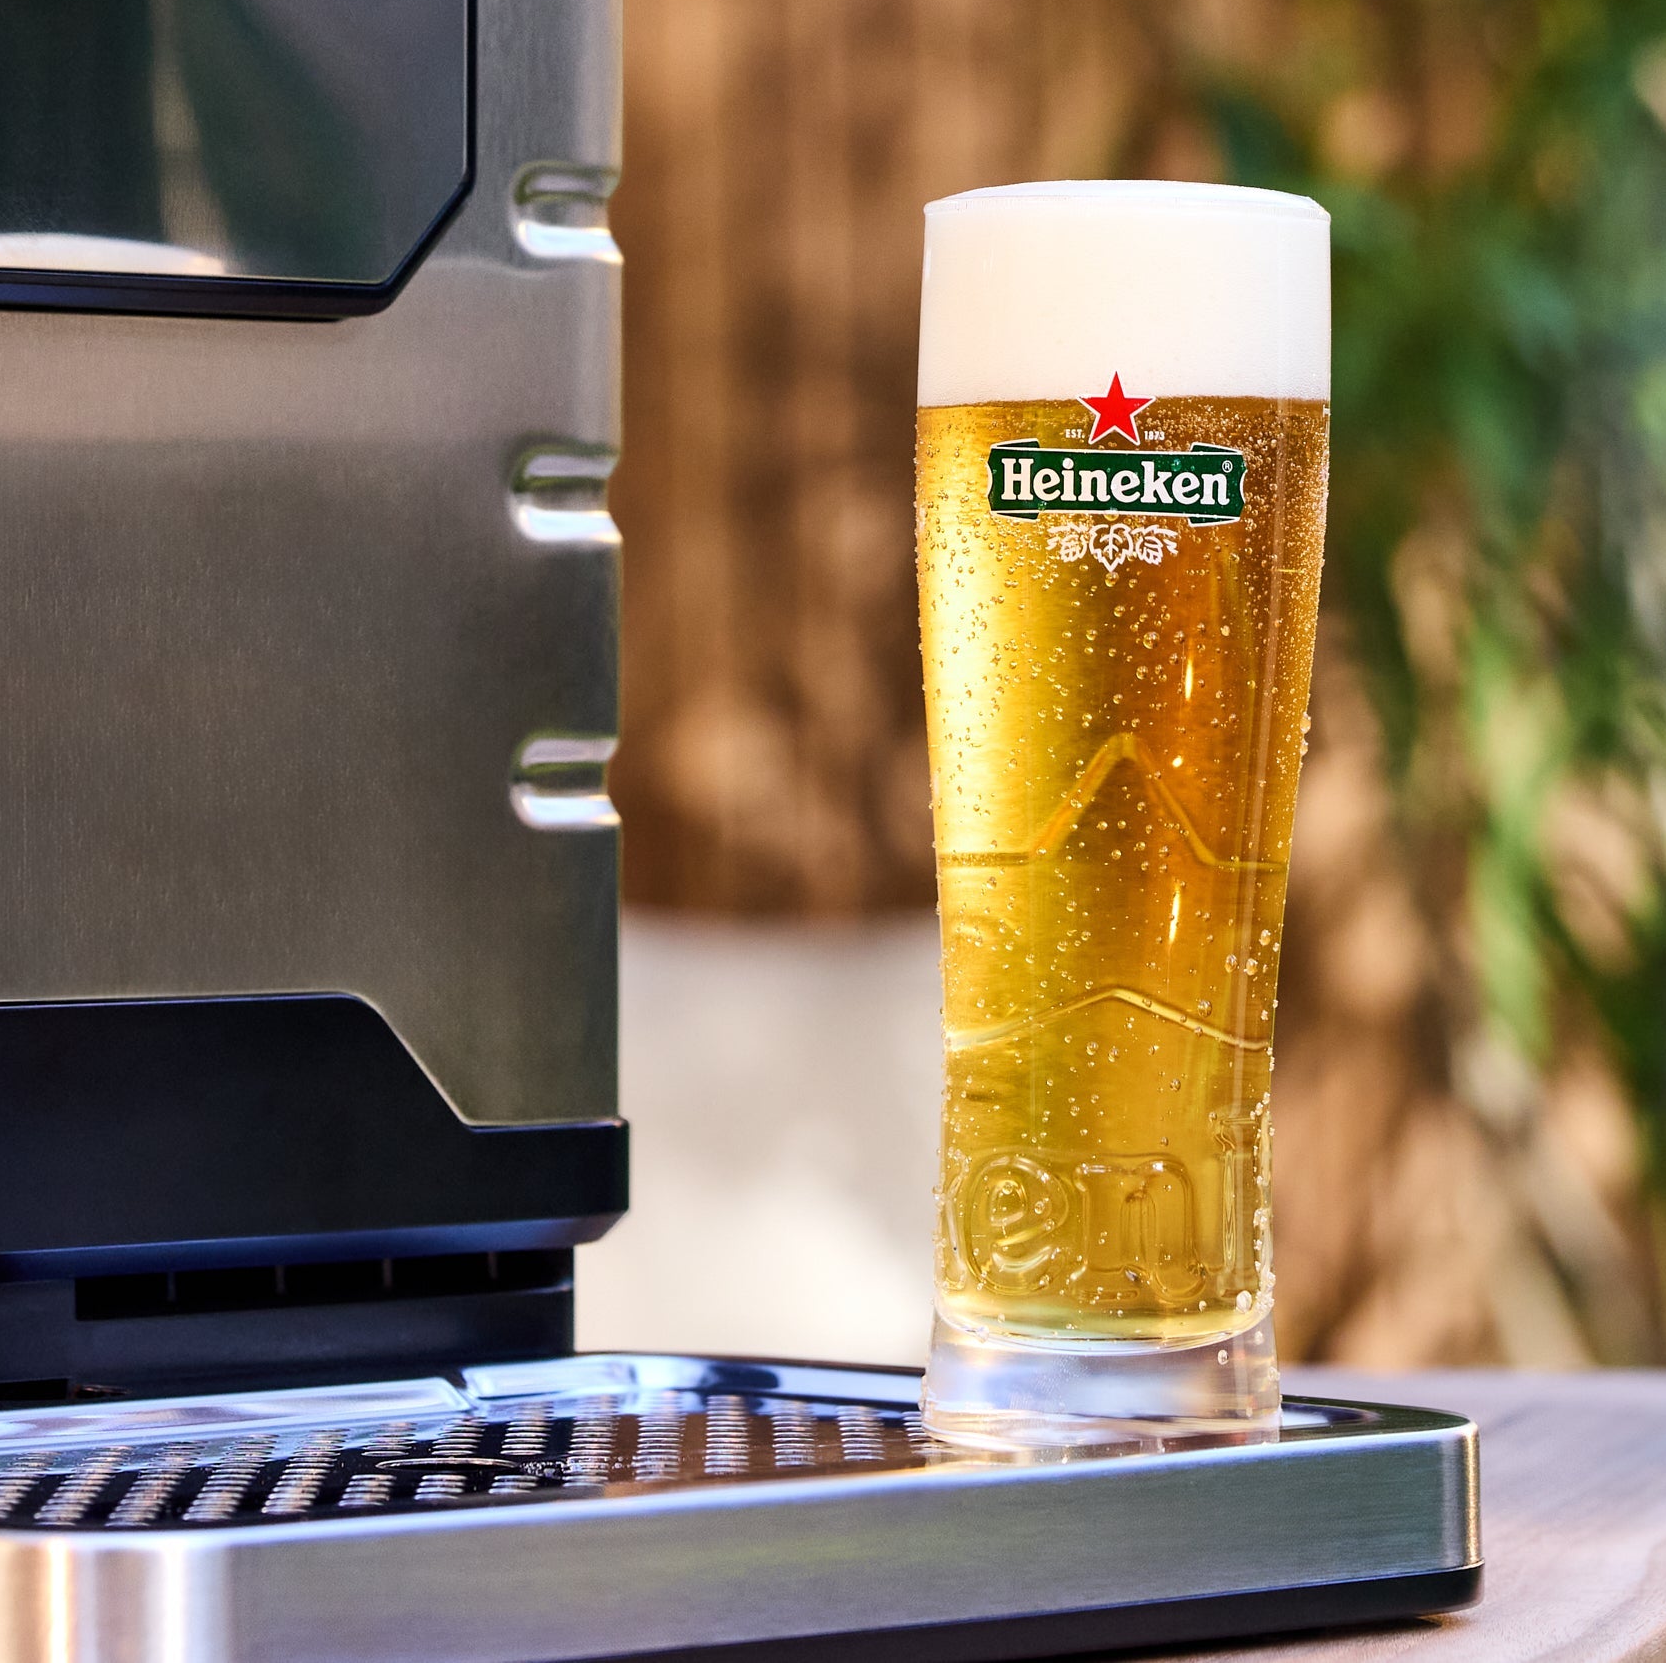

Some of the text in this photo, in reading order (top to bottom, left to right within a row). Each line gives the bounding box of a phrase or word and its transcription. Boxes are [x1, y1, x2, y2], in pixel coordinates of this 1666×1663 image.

[1065, 428, 1165, 441] EST. 1873
[1000, 457, 1230, 506] Heineken
